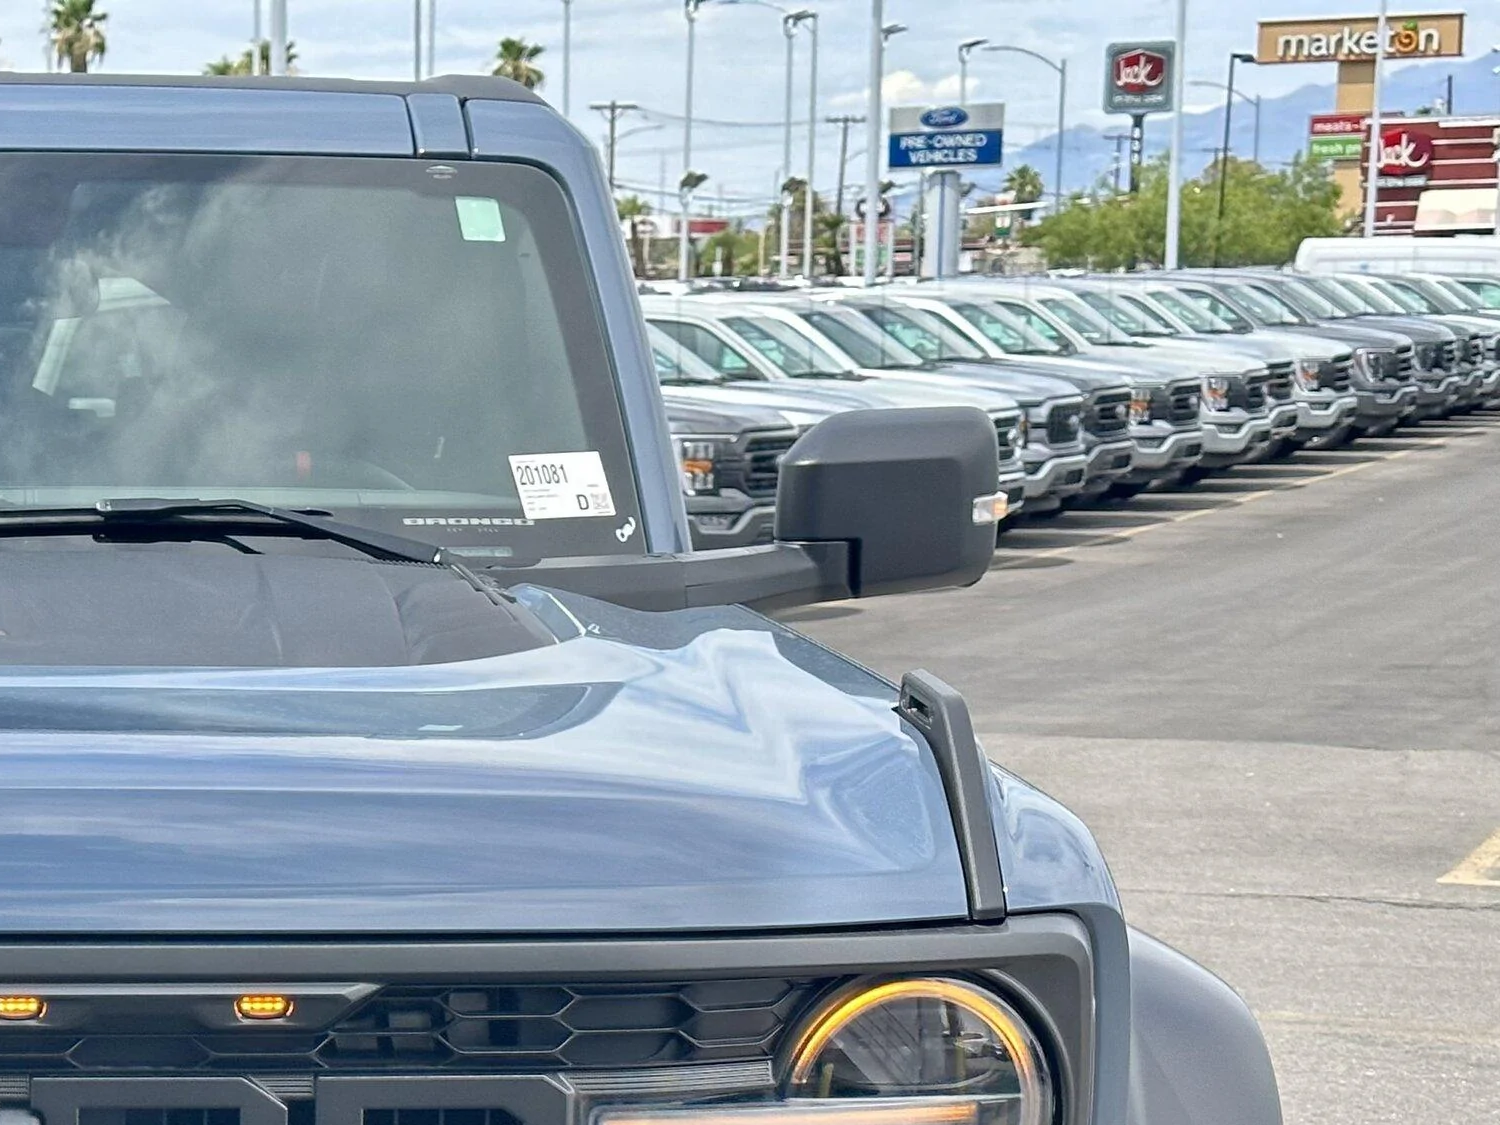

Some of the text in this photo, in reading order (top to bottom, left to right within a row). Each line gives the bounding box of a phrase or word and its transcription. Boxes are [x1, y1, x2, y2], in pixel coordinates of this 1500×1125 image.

[1277, 22, 1439, 56] marketon
[900, 133, 987, 150] PRE-OWNED
[908, 148, 978, 164] VEHICLES
[516, 464, 568, 485] 201081
[576, 494, 590, 510] D
